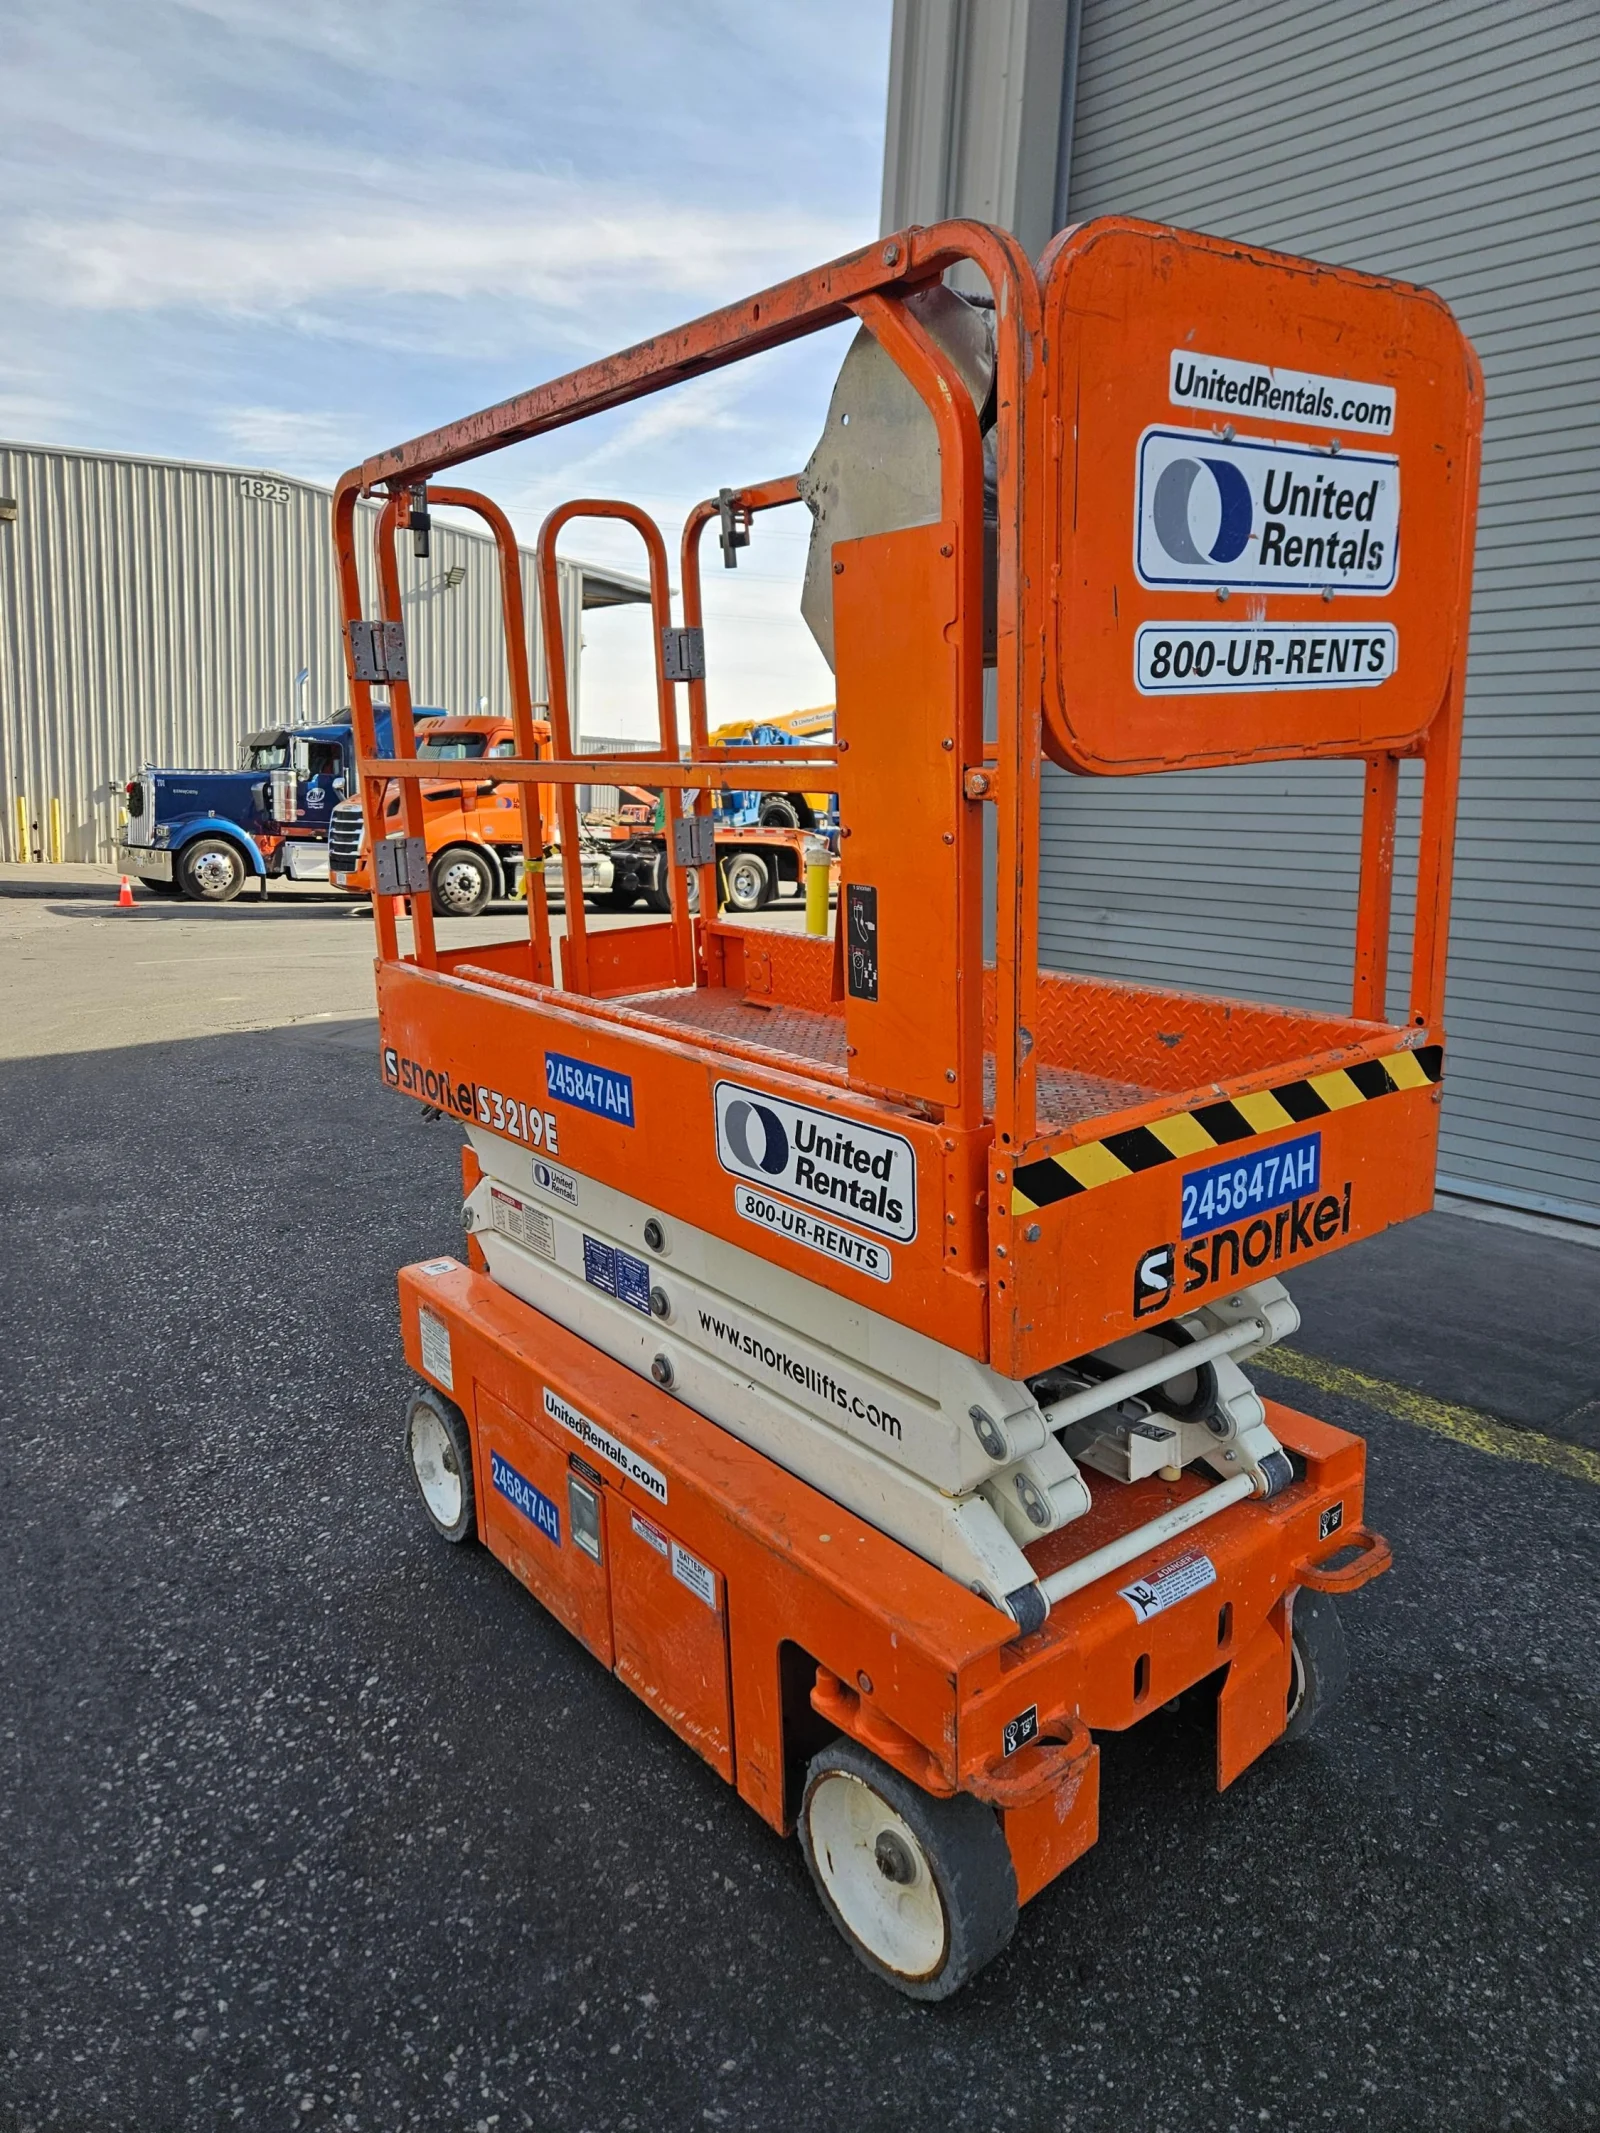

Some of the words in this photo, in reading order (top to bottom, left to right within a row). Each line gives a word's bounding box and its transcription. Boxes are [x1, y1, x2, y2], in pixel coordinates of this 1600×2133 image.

[1173, 362, 1392, 427] UnitedRentals.com
[241, 479, 290, 502] 1825
[1263, 469, 1379, 522] United
[1259, 521, 1385, 571] Rentals
[1150, 637, 1387, 679] 800-UR-RENTS
[546, 1059, 631, 1118] 245847AH
[477, 1086, 559, 1156] S3219E
[794, 1119, 893, 1182] United
[551, 1171, 573, 1190] United
[551, 1181, 576, 1202] Rentals
[795, 1155, 903, 1224] Rentals
[1182, 1145, 1316, 1229] 245847AH
[745, 1195, 880, 1270] 800-UR-RENTS
[1184, 1181, 1352, 1293] snorkel
[698, 1309, 902, 1441] www.snorkellifts.com
[545, 1392, 665, 1498] UnitedRentals.com
[491, 1457, 558, 1539] 245847AH
[678, 1549, 706, 1577] BATTERY
[1161, 1555, 1194, 1578] DANGER
